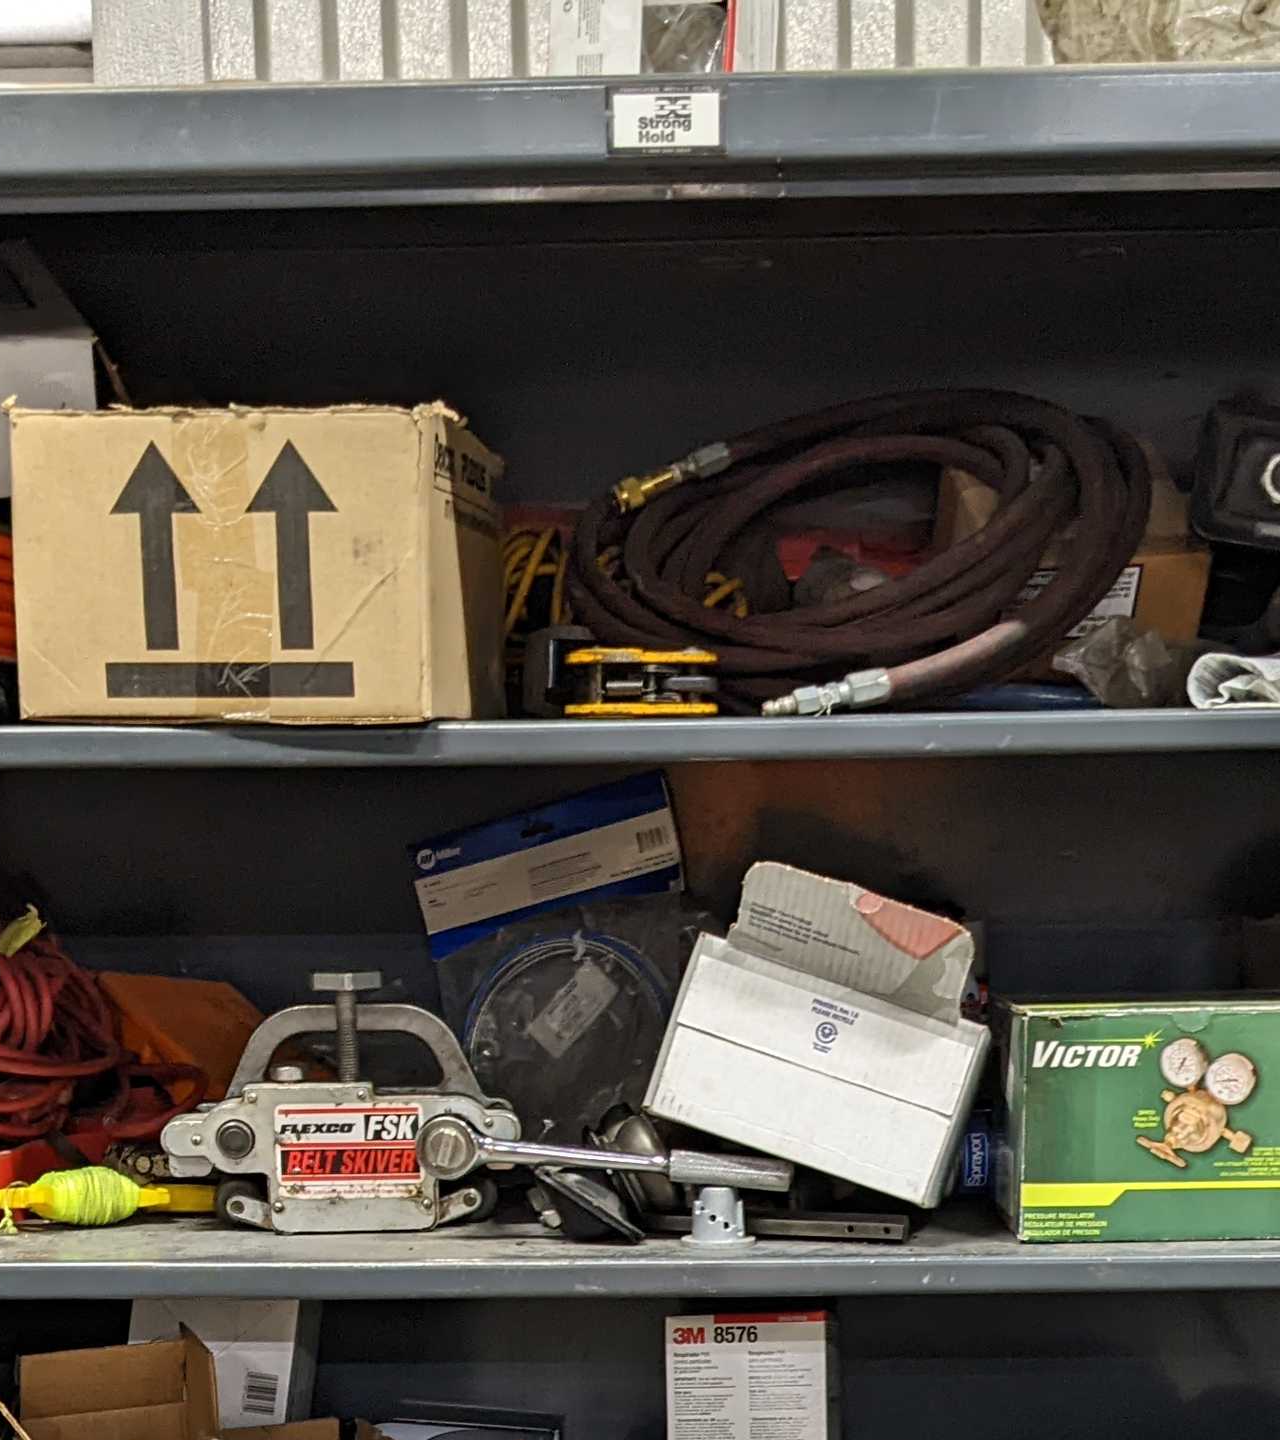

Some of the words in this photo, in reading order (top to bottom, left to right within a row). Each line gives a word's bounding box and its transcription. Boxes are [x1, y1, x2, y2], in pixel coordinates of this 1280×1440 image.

[638, 117, 692, 131] Strong
[638, 131, 675, 143] Hold
[1032, 1040, 1142, 1068] VICTOR
[279, 1123, 355, 1135] FLEXCO
[366, 1115, 416, 1140] FSK
[287, 1151, 337, 1174] BELT
[340, 1150, 417, 1174] SKIVER
[968, 1134, 984, 1185] Sprayon
[673, 1327, 706, 1344] 3M
[714, 1326, 758, 1343] 8576
